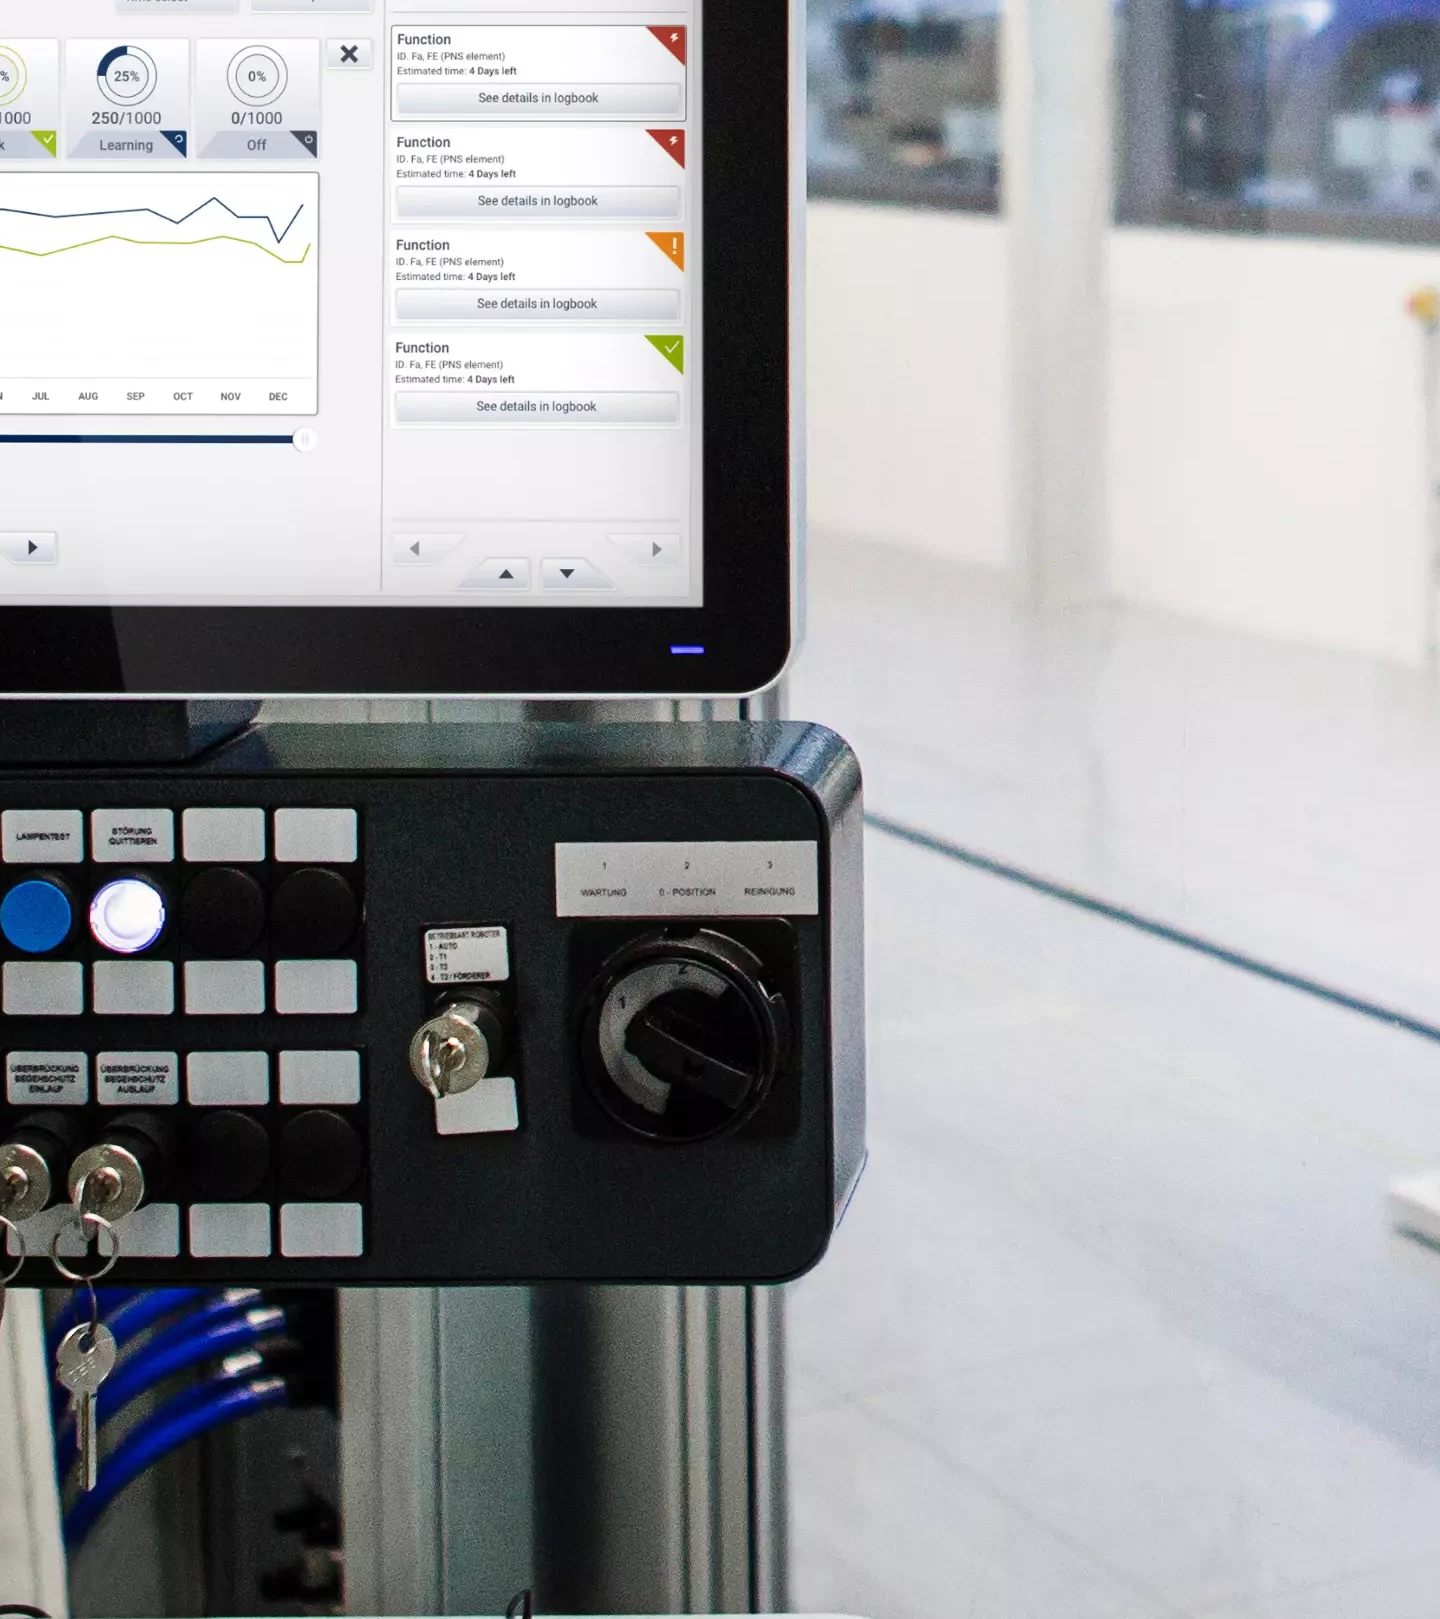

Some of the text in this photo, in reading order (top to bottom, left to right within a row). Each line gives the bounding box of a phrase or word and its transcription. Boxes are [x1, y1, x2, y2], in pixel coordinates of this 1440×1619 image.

[397, 33, 452, 46] Function
[427, 51, 438, 61] FE
[440, 51, 464, 62] (PNS
[465, 51, 506, 62] element)
[114, 70, 140, 82] 25%
[248, 70, 267, 82] 0%
[397, 66, 517, 78] Estimated time: 4 Days left
[478, 92, 599, 106] See details in logbook
[91, 111, 162, 126] 250/1000
[231, 111, 283, 126] 0/1000
[99, 139, 154, 154] Learning
[247, 138, 267, 151] Off
[396, 136, 451, 148] Function
[396, 239, 450, 251] Function
[395, 341, 450, 354] Function
[31, 391, 50, 401] JUL
[78, 391, 99, 401] AUG
[126, 391, 146, 401] SEP
[173, 391, 193, 401] OCT
[220, 392, 241, 401] NOV
[268, 392, 288, 401] DEC
[476, 400, 597, 415] See details in logbook
[112, 826, 152, 835] STÖRUNG
[16, 832, 70, 841] LAMPENTEST
[109, 837, 157, 845] QUITTIEREN
[602, 861, 607, 870] 1
[684, 861, 690, 870] 2
[767, 860, 773, 870] 3
[581, 888, 627, 897] WARTUNG
[673, 888, 716, 896] POSITION
[745, 888, 795, 896] REINIGUNG
